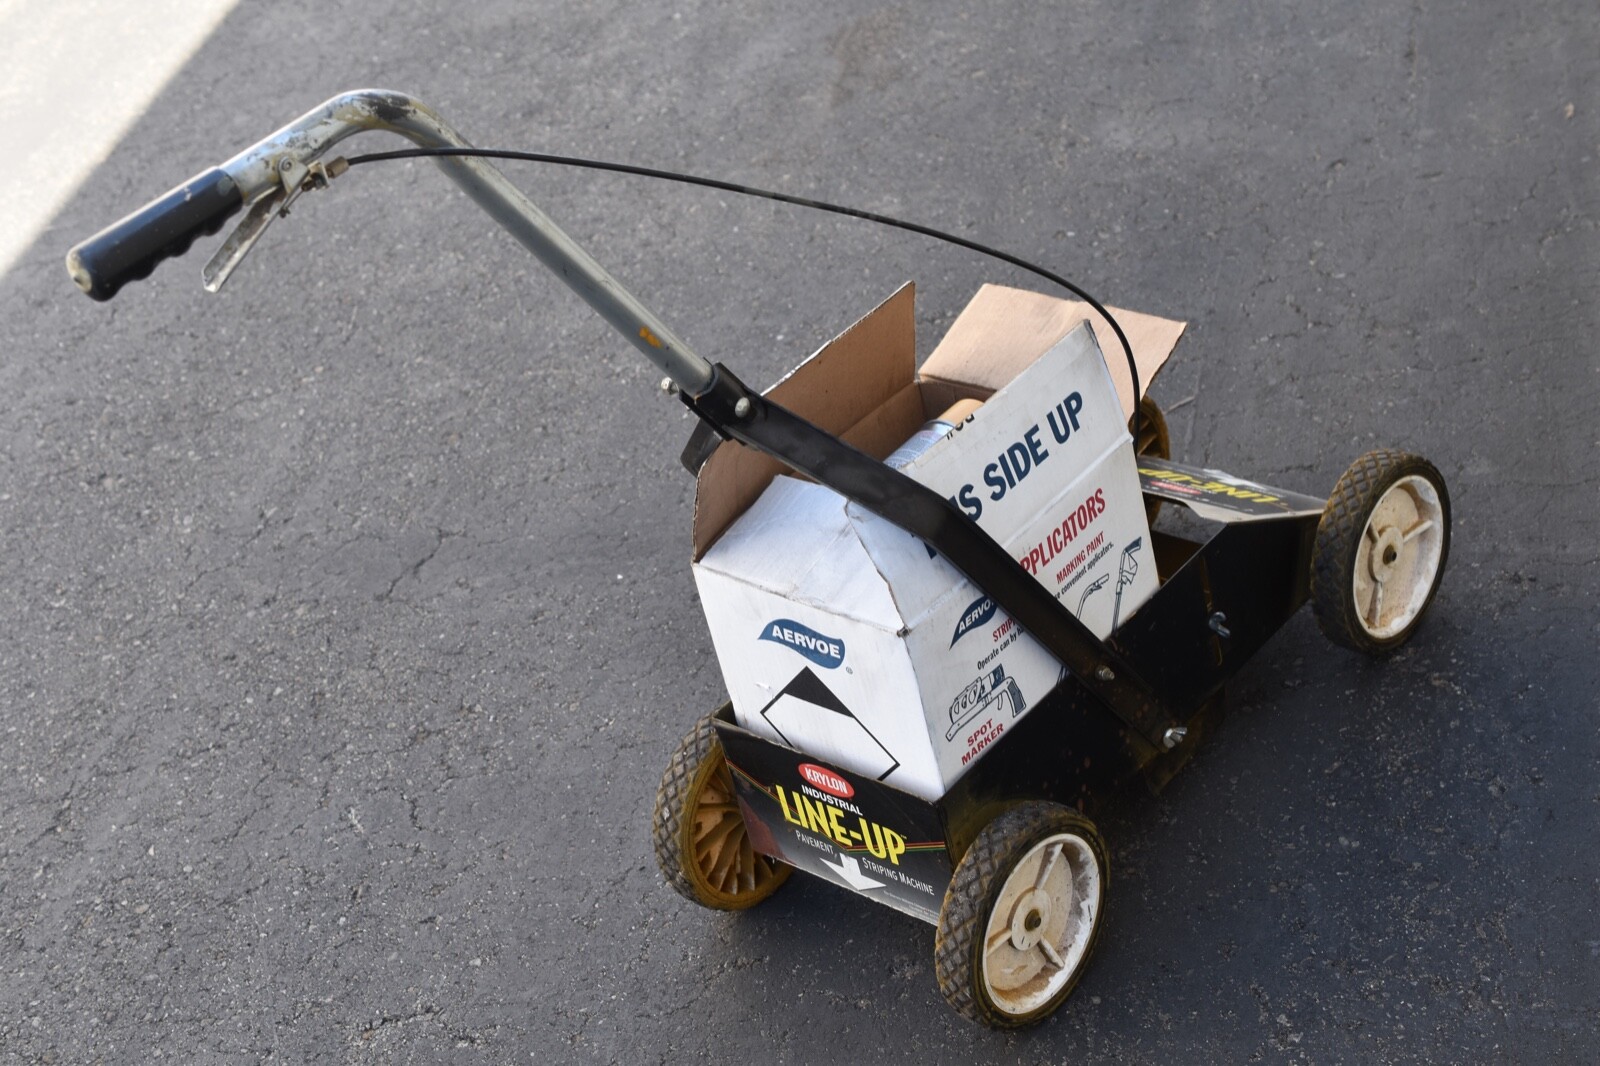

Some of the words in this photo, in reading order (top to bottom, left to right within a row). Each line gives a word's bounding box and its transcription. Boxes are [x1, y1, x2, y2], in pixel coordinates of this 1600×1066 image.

[983, 424, 1050, 501] SIDE
[1046, 391, 1083, 445] UP
[1019, 488, 1106, 576] PPLICATORS
[1056, 550, 1086, 585] MARKING
[1086, 531, 1105, 557] PAINT
[958, 599, 995, 634] AERVO
[772, 625, 841, 659] AERVOE
[977, 647, 1000, 671] Operate
[1000, 640, 1010, 652] can
[1009, 632, 1017, 642] by
[961, 723, 1004, 766] MARKER
[967, 718, 993, 747] SPOT
[801, 784, 864, 816] INDUSTRIAL
[804, 767, 848, 795] KRYLON
[795, 830, 834, 855] PAVEMENT
[862, 857, 899, 881] STRIPING
[898, 872, 935, 896] MACHINE
